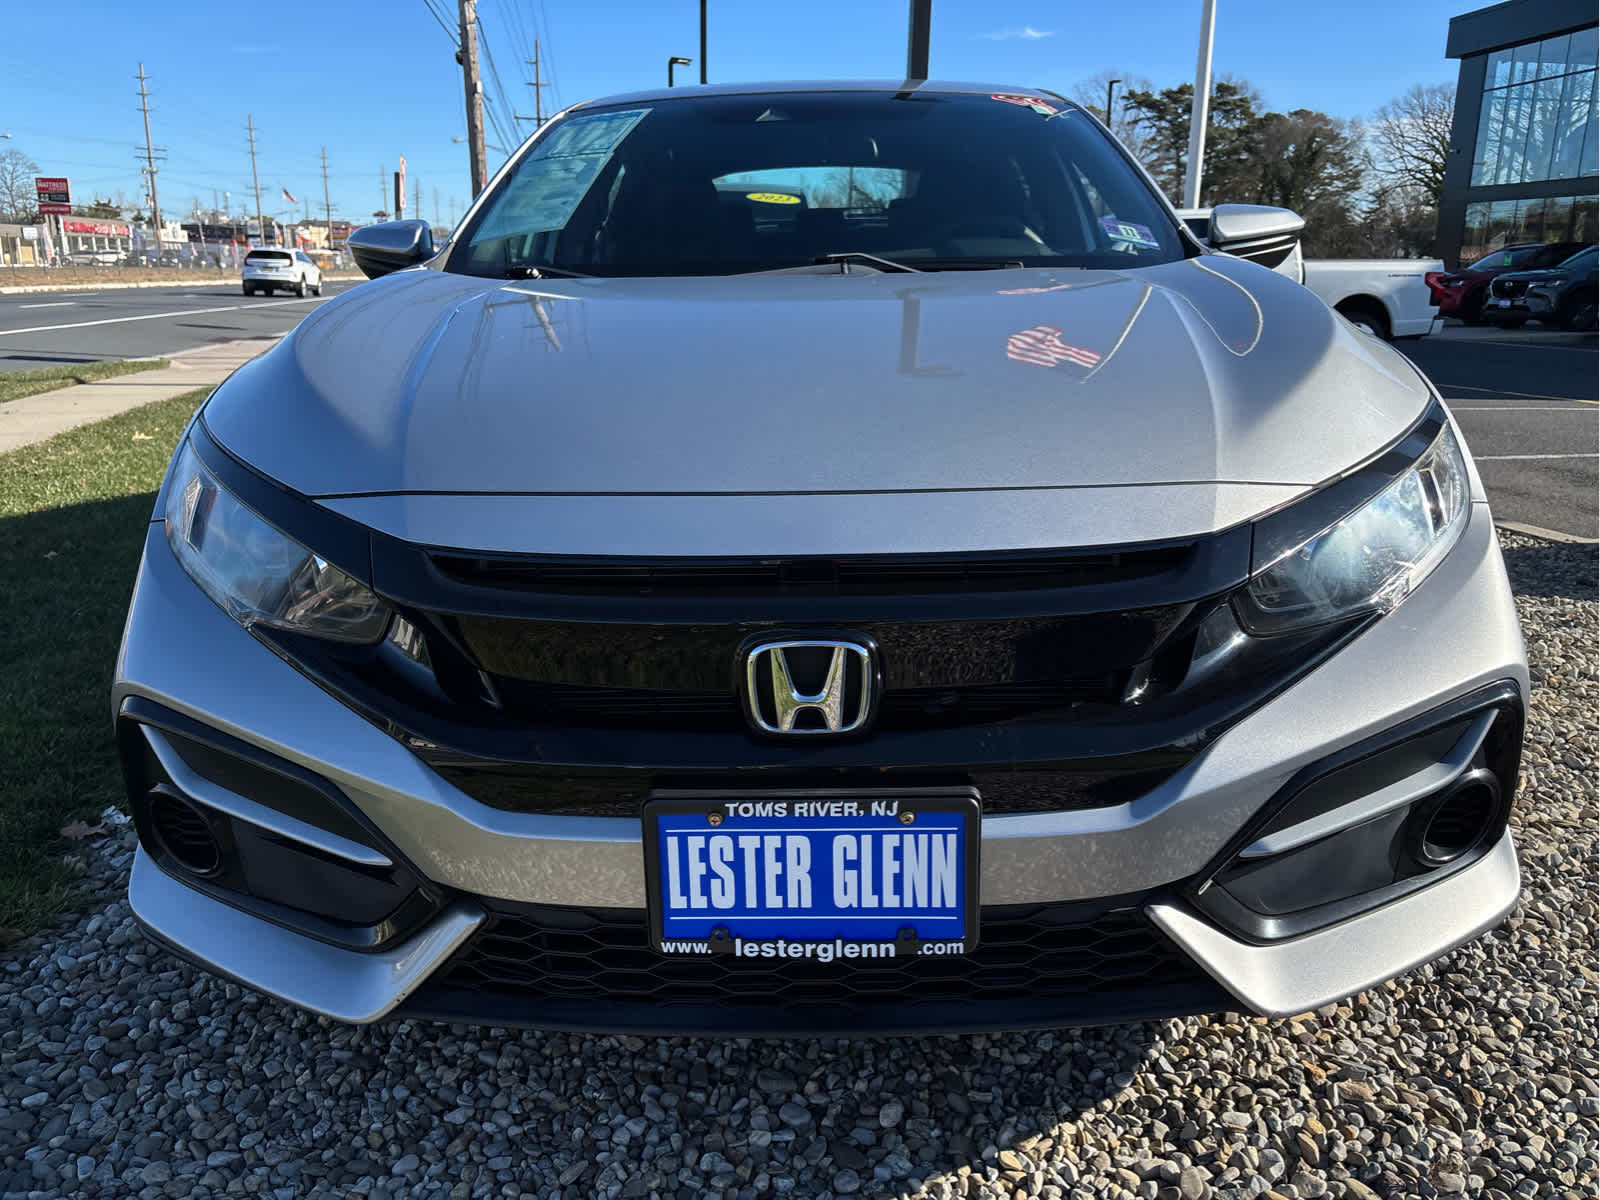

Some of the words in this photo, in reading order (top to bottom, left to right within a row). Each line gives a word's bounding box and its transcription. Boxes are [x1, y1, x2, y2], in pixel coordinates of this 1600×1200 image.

[725, 801, 788, 818] TOMS
[794, 801, 865, 818] RIVER,
[871, 800, 899, 817] NJ
[666, 835, 812, 909] LESTER
[832, 833, 958, 908] GLENN
[660, 941, 713, 955] www.
[734, 938, 896, 962] lesterglenn
[916, 940, 965, 956] .com
